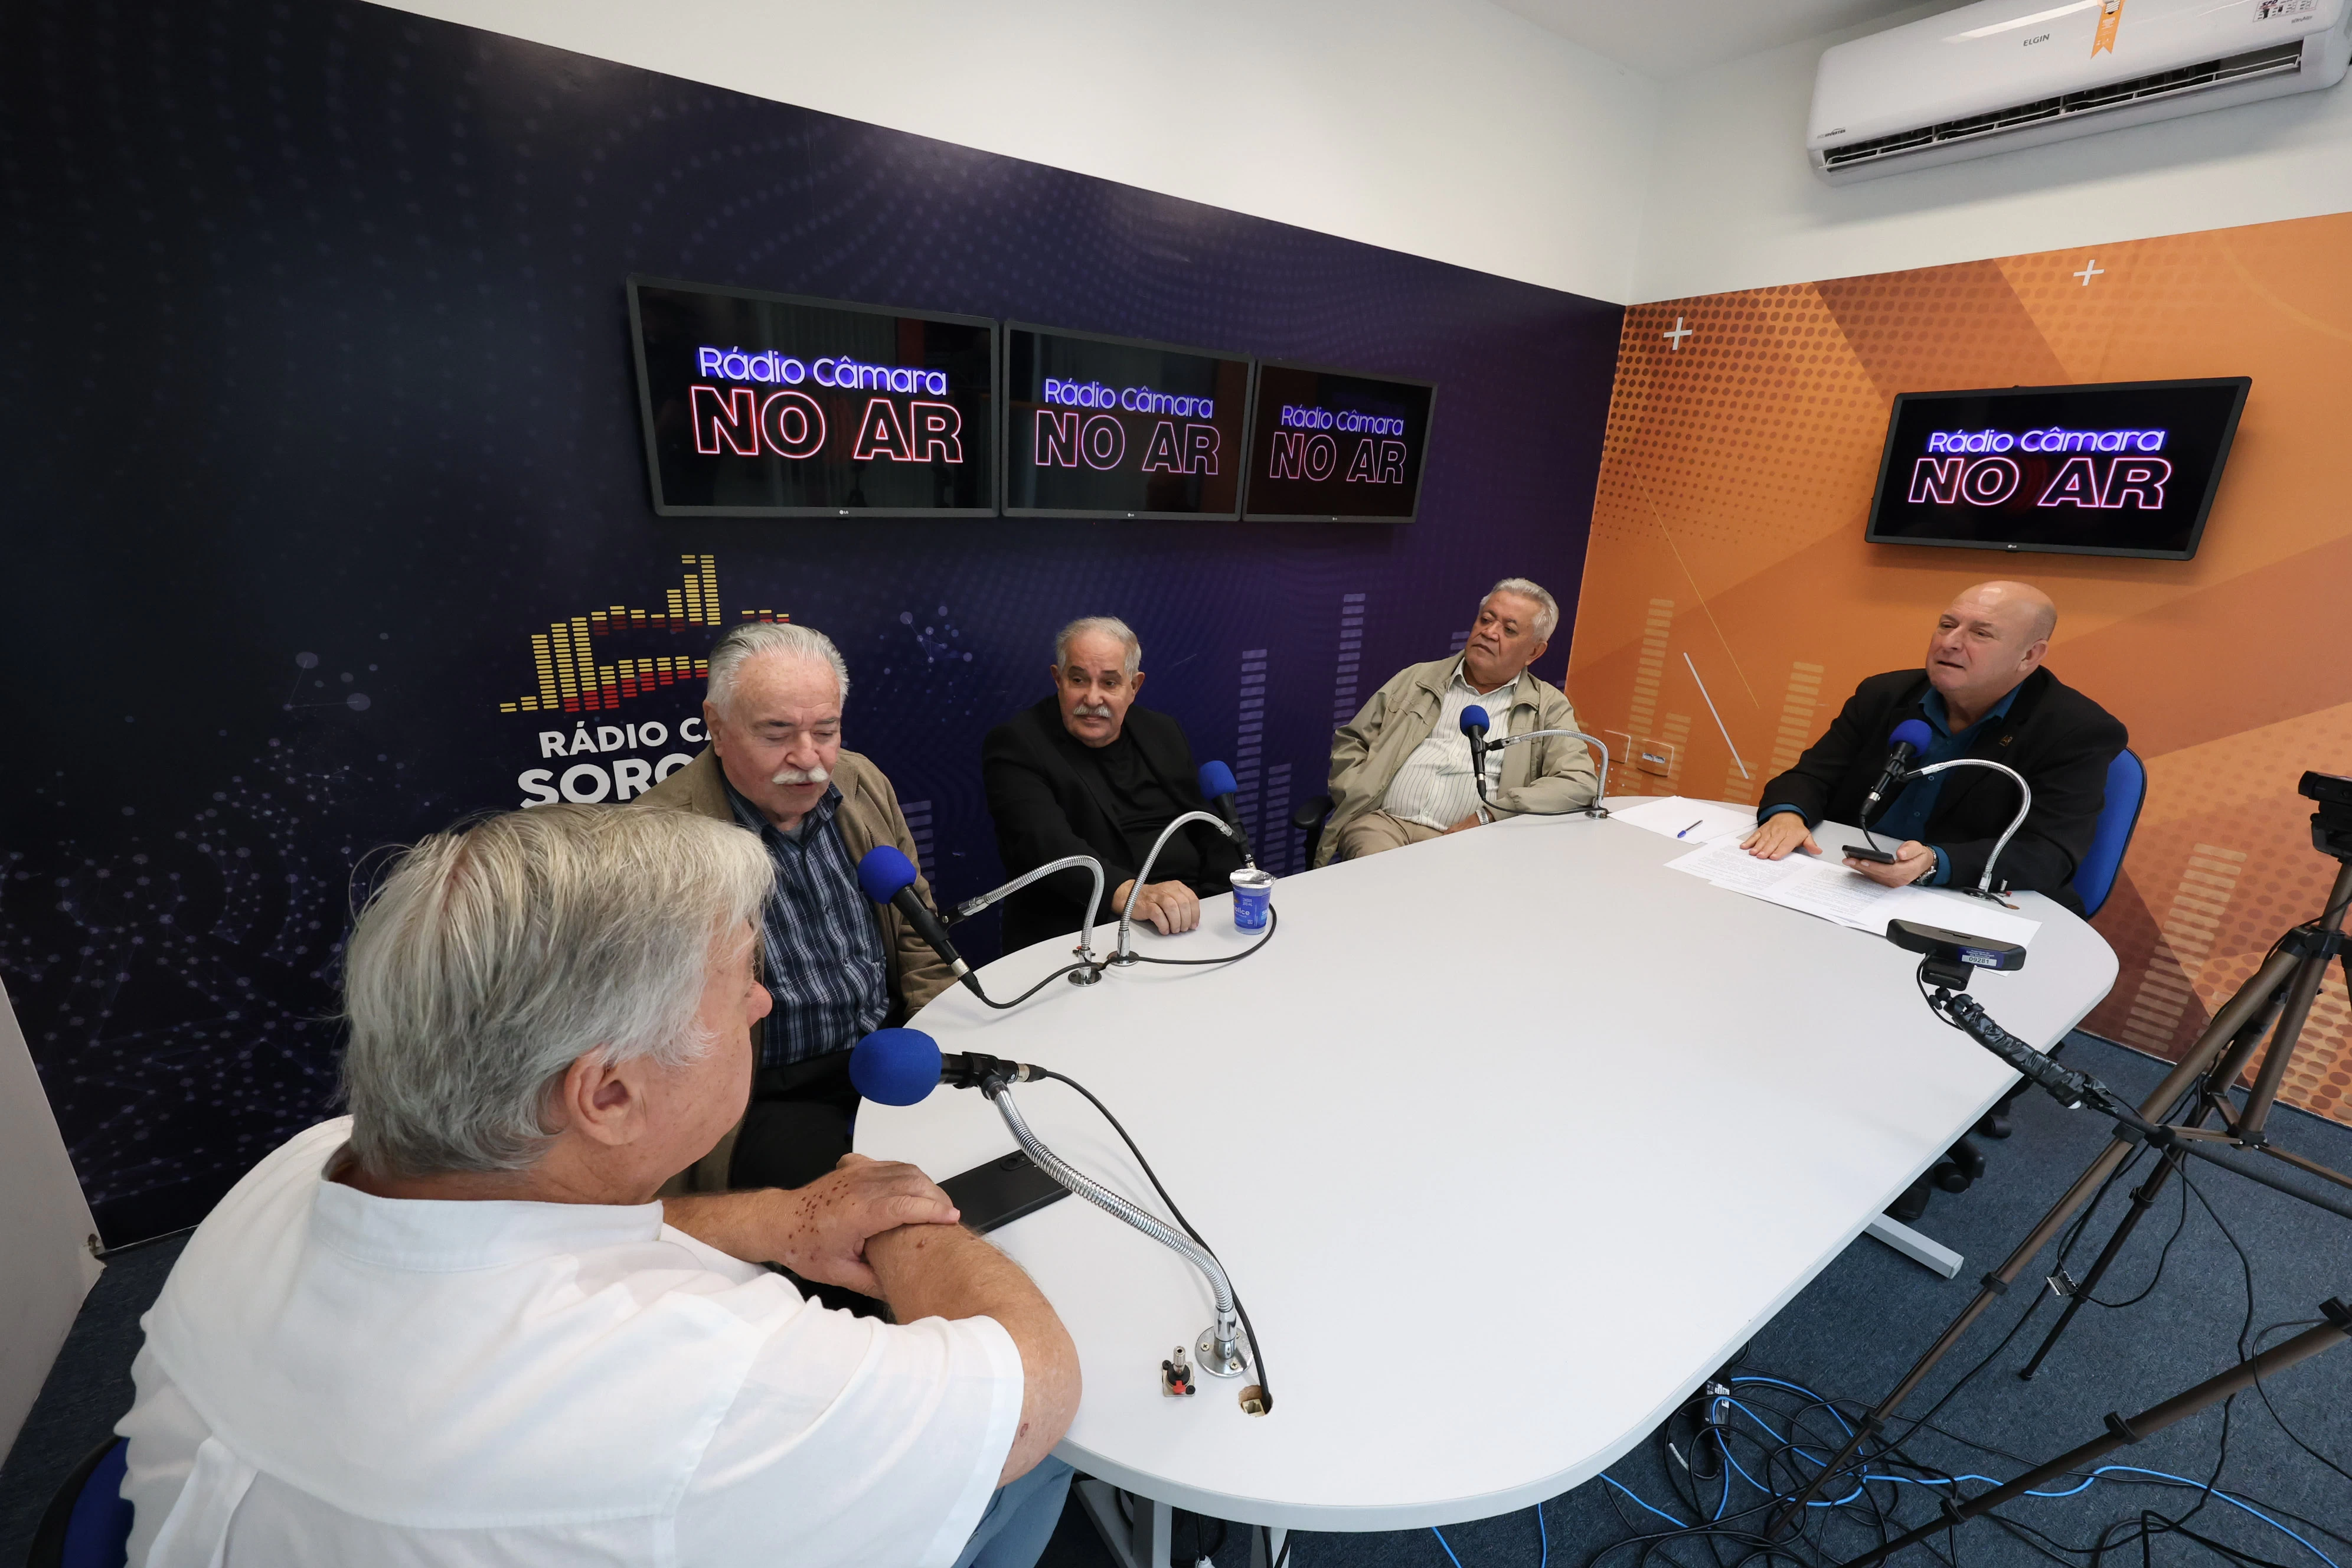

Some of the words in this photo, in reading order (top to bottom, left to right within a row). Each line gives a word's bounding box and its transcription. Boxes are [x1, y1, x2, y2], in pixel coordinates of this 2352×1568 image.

[2023, 33, 2050, 47] ELGIN
[698, 346, 805, 384] Rádio
[813, 355, 947, 396] Câmara
[1044, 377, 1116, 409] Rádio
[1121, 385, 1214, 419] Câmara
[1281, 404, 1333, 429] Rádio
[1336, 409, 1404, 436] Câmara
[690, 386, 826, 459] NO
[853, 398, 963, 463] AR
[1035, 410, 1125, 471] NO
[1141, 421, 1220, 475] AR
[1928, 429, 2014, 453] Rádio
[2020, 426, 2166, 453] Câmara
[1269, 432, 1337, 481] NO
[1345, 439, 1407, 484] AR
[1908, 458, 2020, 506] NO
[2037, 458, 2172, 509] AR
[538, 720, 668, 758] RÁDIO
